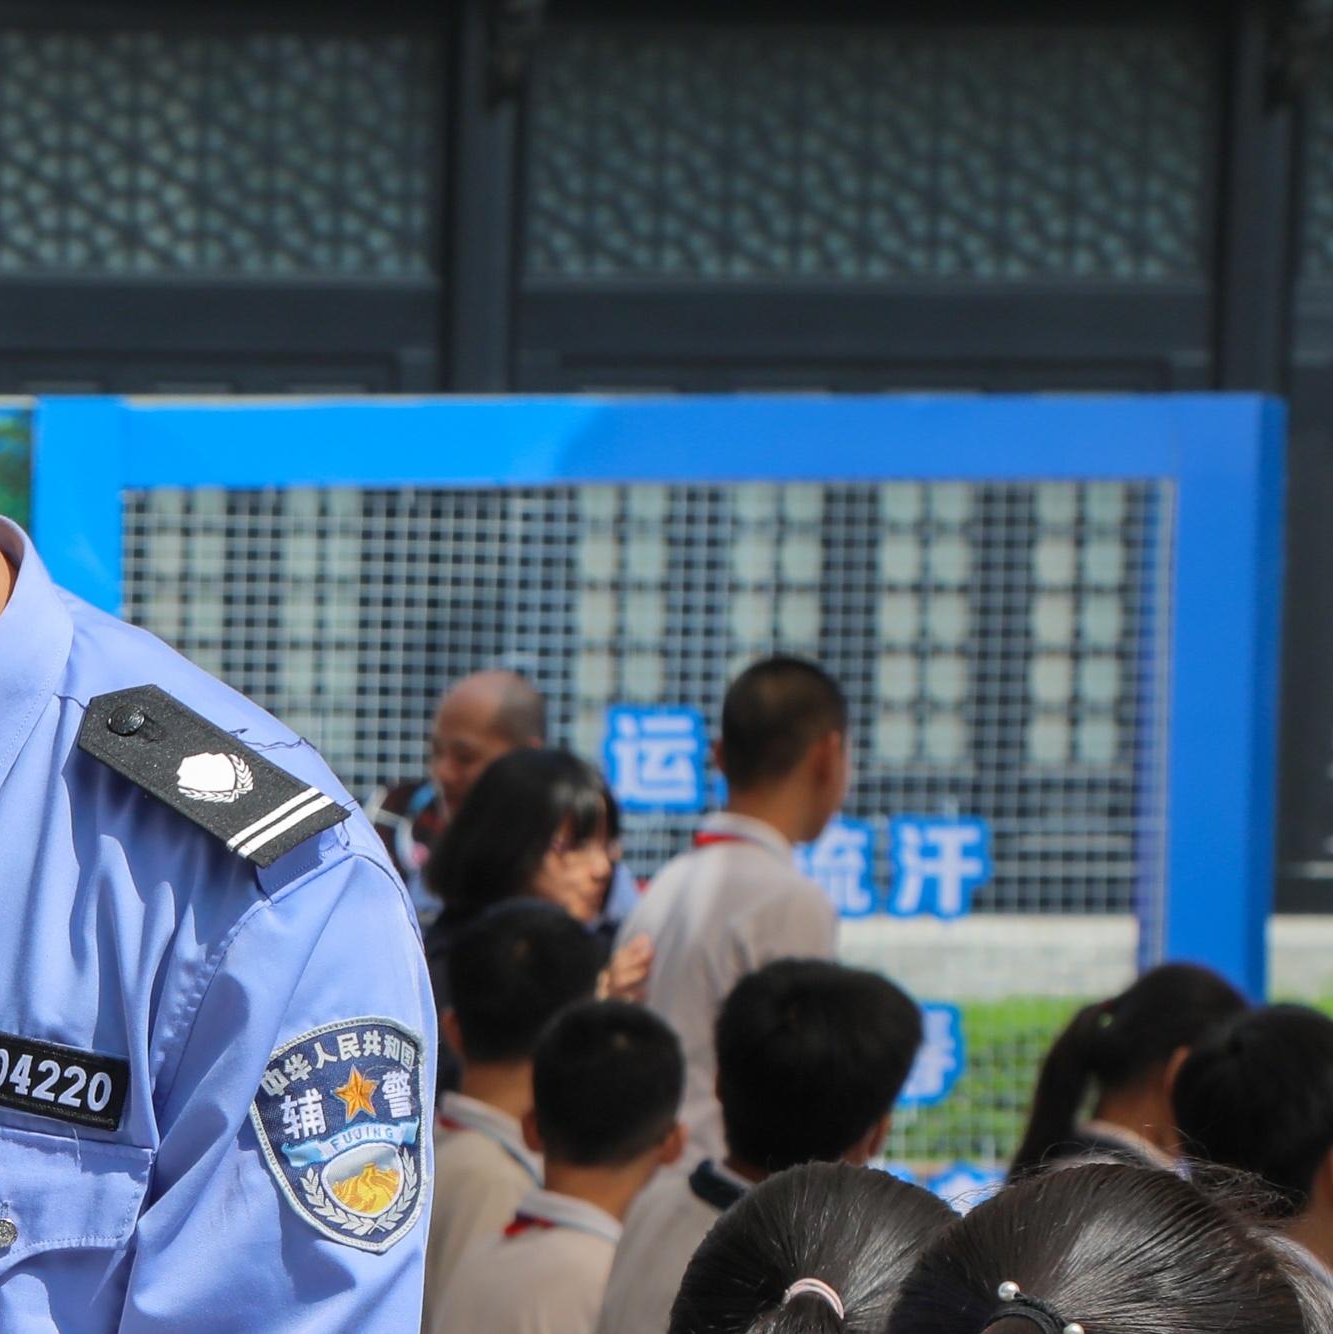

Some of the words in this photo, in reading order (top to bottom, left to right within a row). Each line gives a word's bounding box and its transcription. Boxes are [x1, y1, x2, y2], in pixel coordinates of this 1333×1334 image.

[261, 1030, 416, 1096] 中华人民共和国
[331, 1126, 394, 1151] FUJING
